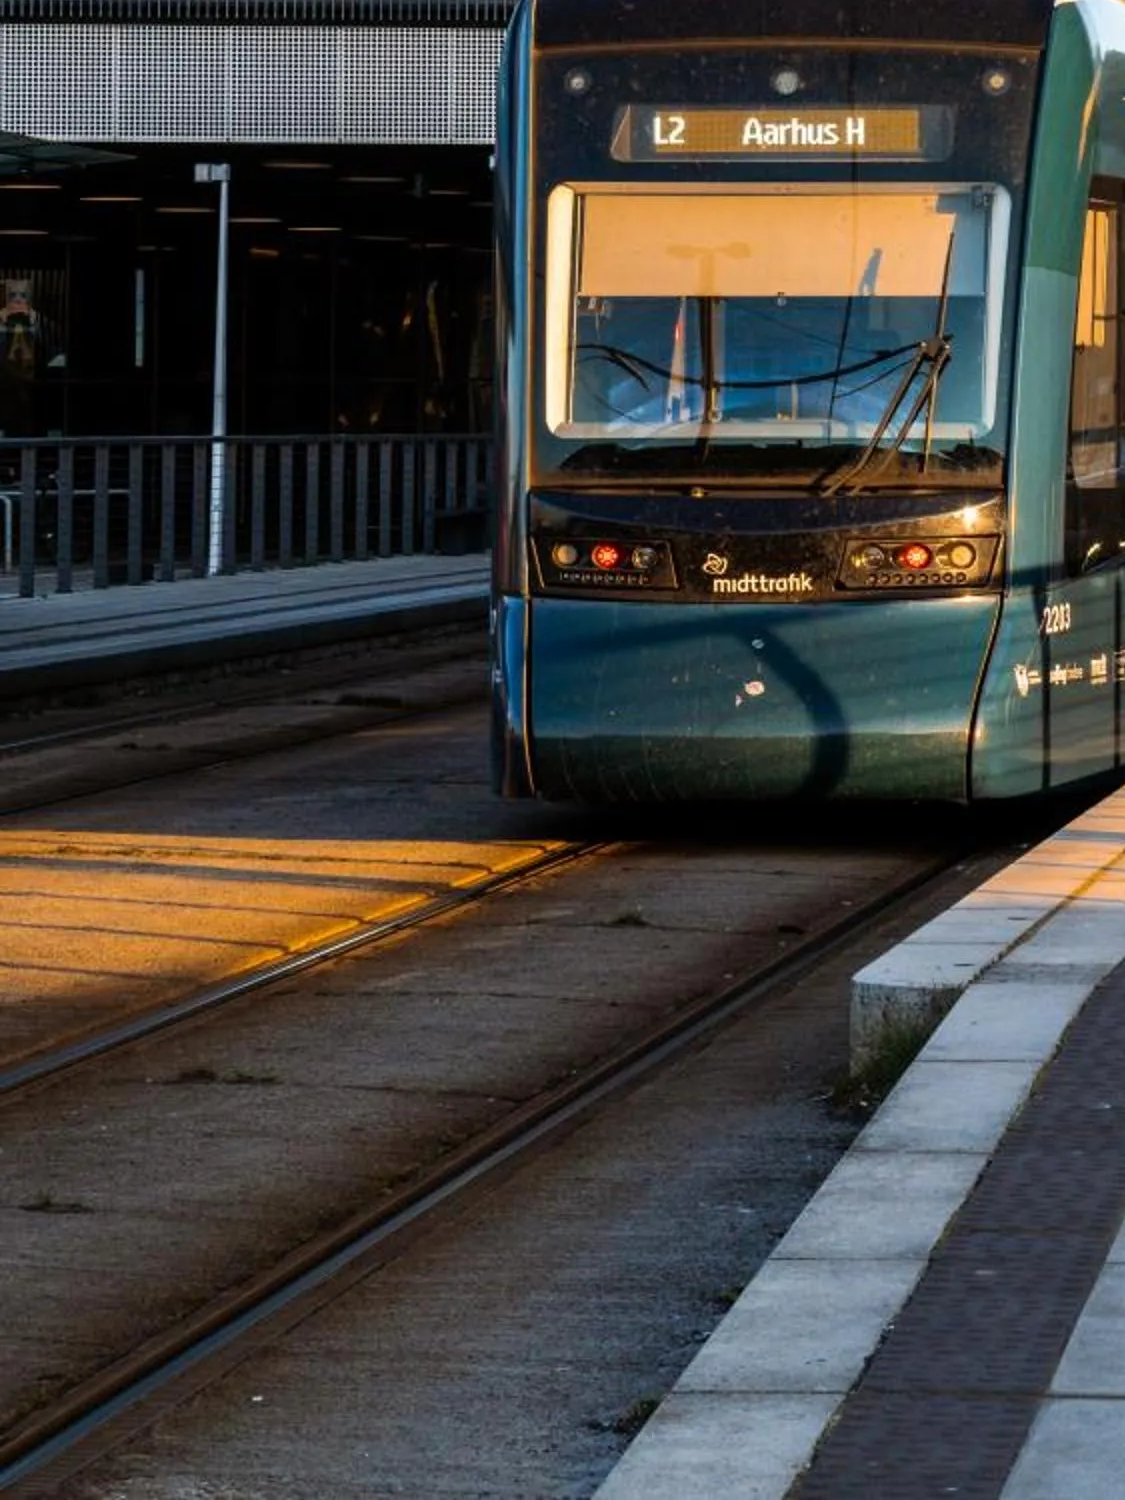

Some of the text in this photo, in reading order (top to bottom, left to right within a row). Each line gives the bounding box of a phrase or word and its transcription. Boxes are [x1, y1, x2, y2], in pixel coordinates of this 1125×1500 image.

[653, 116, 866, 146] L2 Aarhus H
[713, 572, 813, 593] midttrafik
